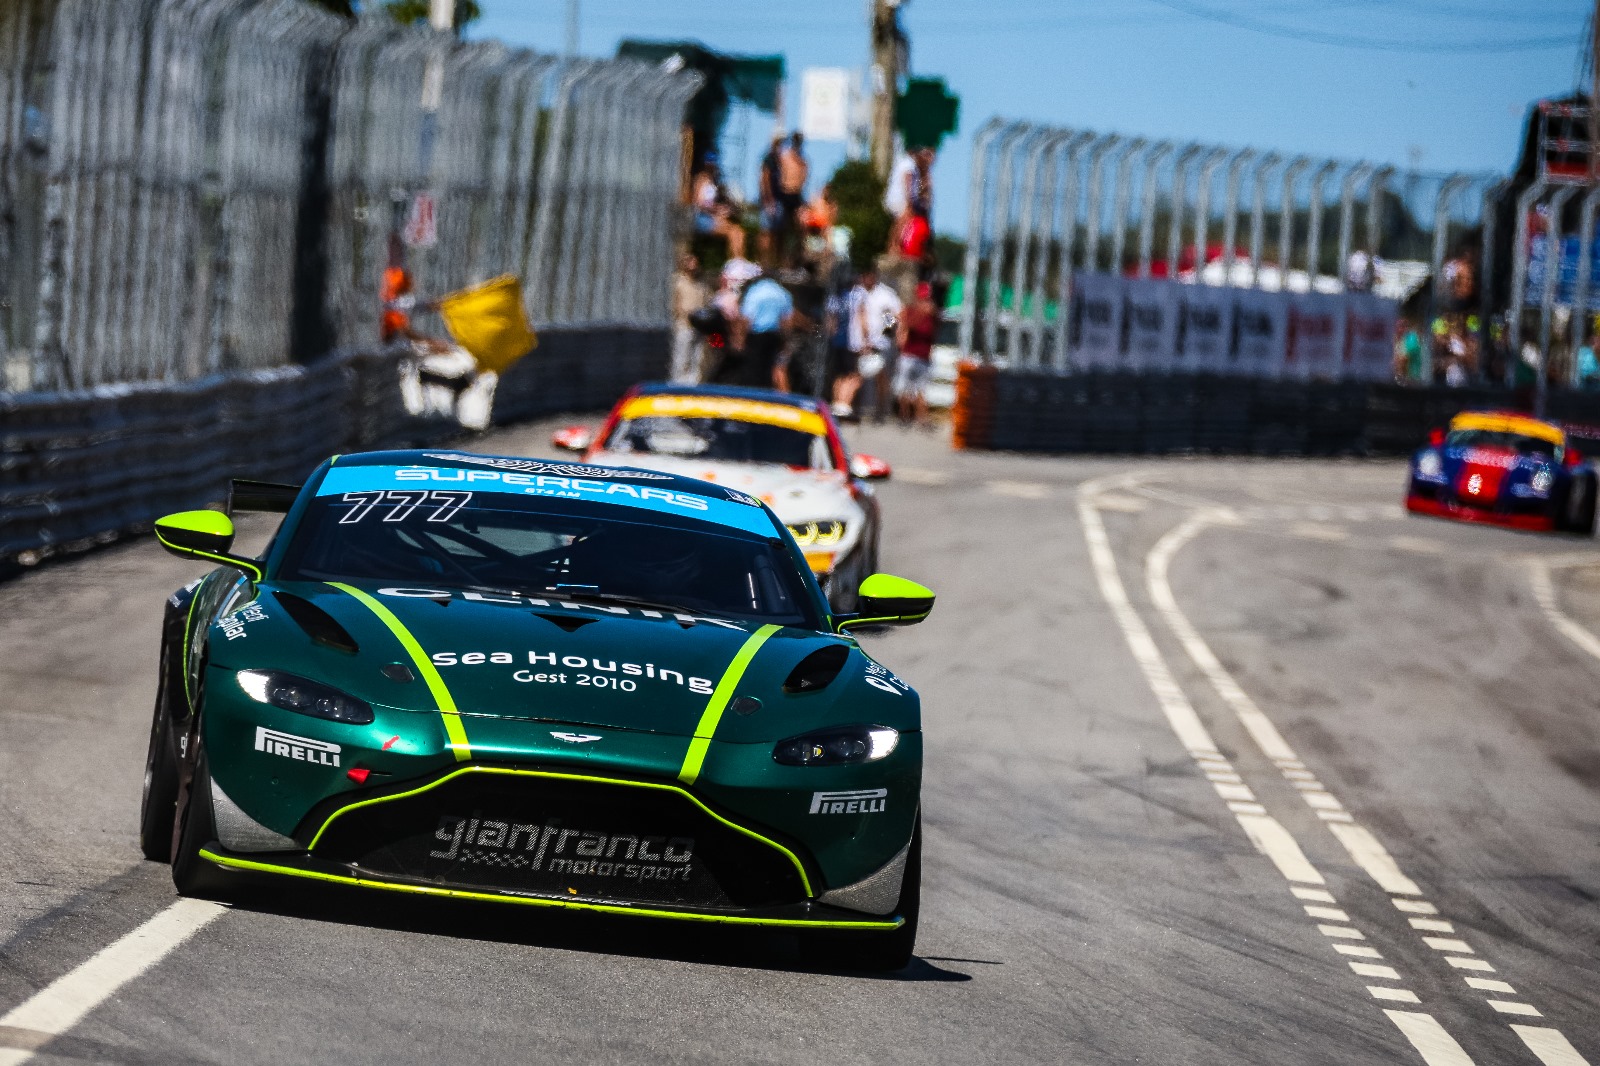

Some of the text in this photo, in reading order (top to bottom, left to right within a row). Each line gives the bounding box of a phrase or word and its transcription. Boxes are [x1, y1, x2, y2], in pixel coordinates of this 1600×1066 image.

[338, 490, 473, 524] 777
[394, 468, 709, 512] SUPERCARS
[524, 487, 581, 498] GT4 AM
[512, 669, 637, 692] Gest 2010
[528, 650, 714, 695] Housing
[254, 725, 342, 768] PIRELLI
[809, 787, 888, 814] PIRELLI
[429, 814, 695, 871] gianfranco
[549, 858, 693, 883] motorsport
